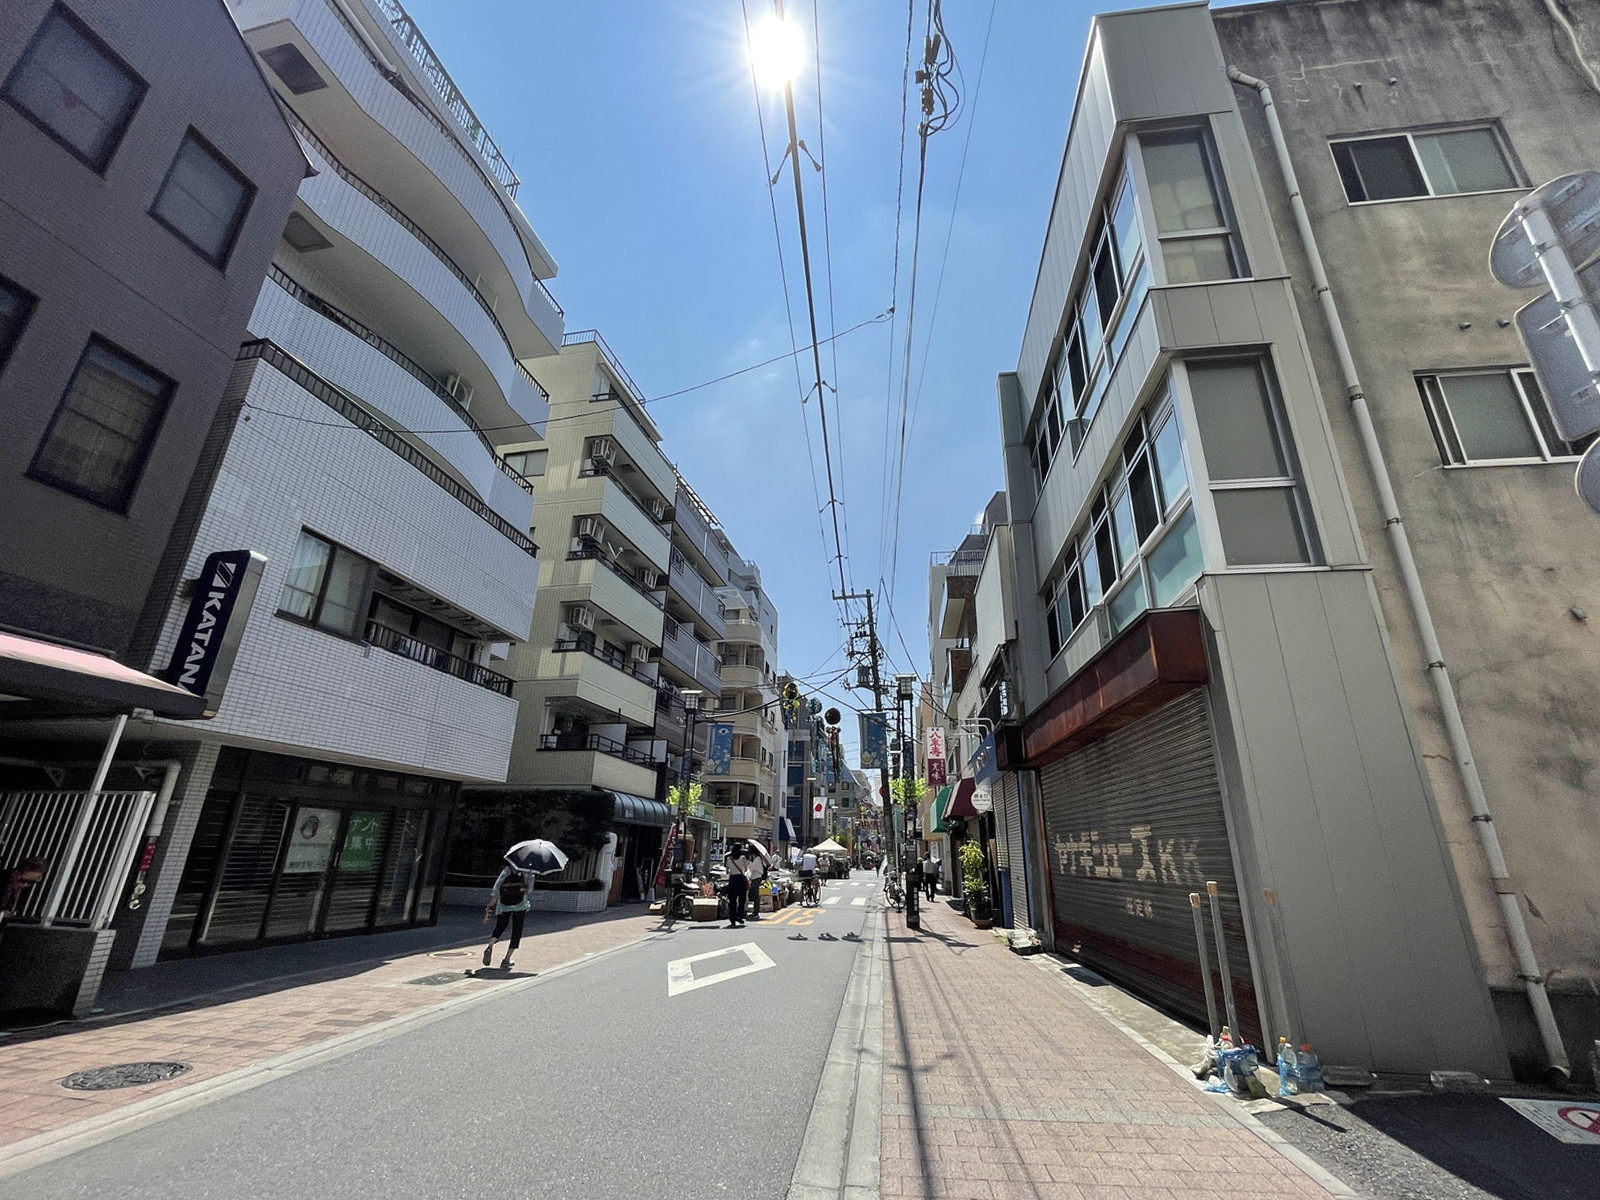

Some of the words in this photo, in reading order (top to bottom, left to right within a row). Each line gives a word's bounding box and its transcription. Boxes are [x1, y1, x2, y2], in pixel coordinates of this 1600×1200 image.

[177, 591, 225, 693] KATAN
[348, 816, 379, 832] ナント
